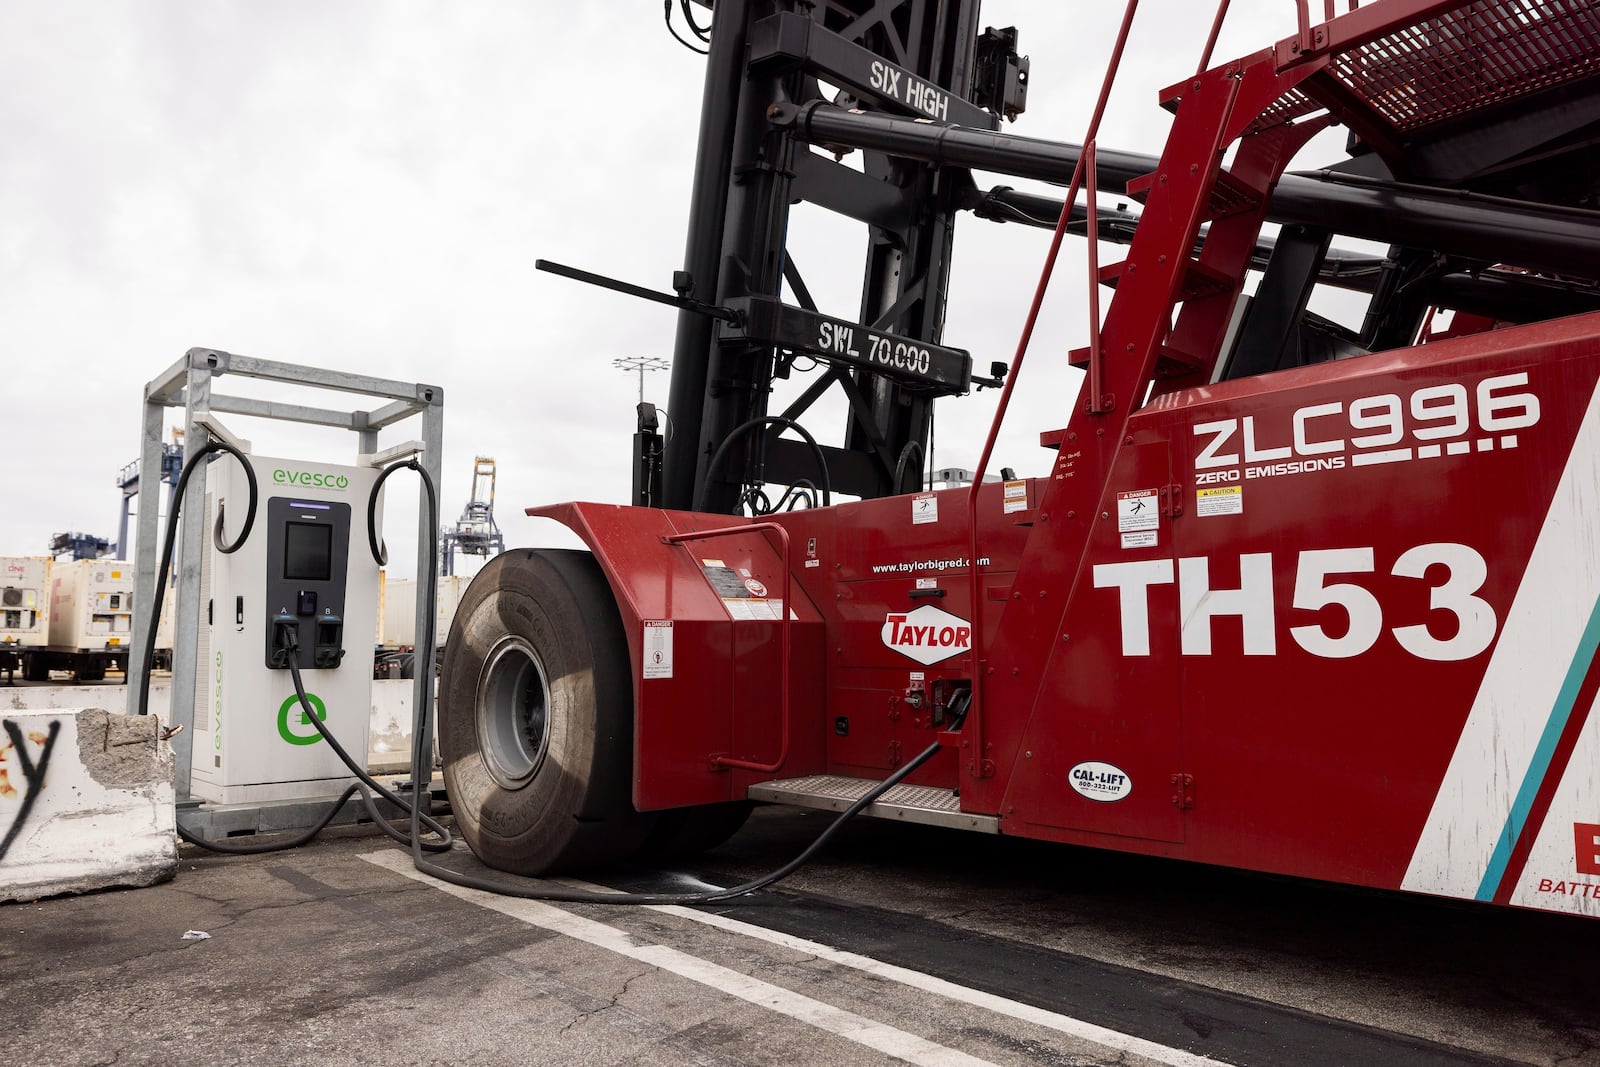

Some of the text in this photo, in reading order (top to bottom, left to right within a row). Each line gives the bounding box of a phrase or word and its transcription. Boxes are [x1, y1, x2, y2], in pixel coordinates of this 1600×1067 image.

[870, 61, 949, 121] SIX HIGH
[818, 321, 859, 357] SWL
[1193, 372, 1541, 470] ZLC996
[1195, 456, 1346, 485] ZERO EMISSIONS
[1128, 490, 1152, 499] DANGER
[1209, 487, 1236, 496] CAUTION
[872, 557, 990, 573] www.taylorbigred.cm
[1092, 542, 1498, 662] TH53
[888, 615, 970, 647] TAYLOR
[1073, 769, 1125, 785] CAL-LIFT
